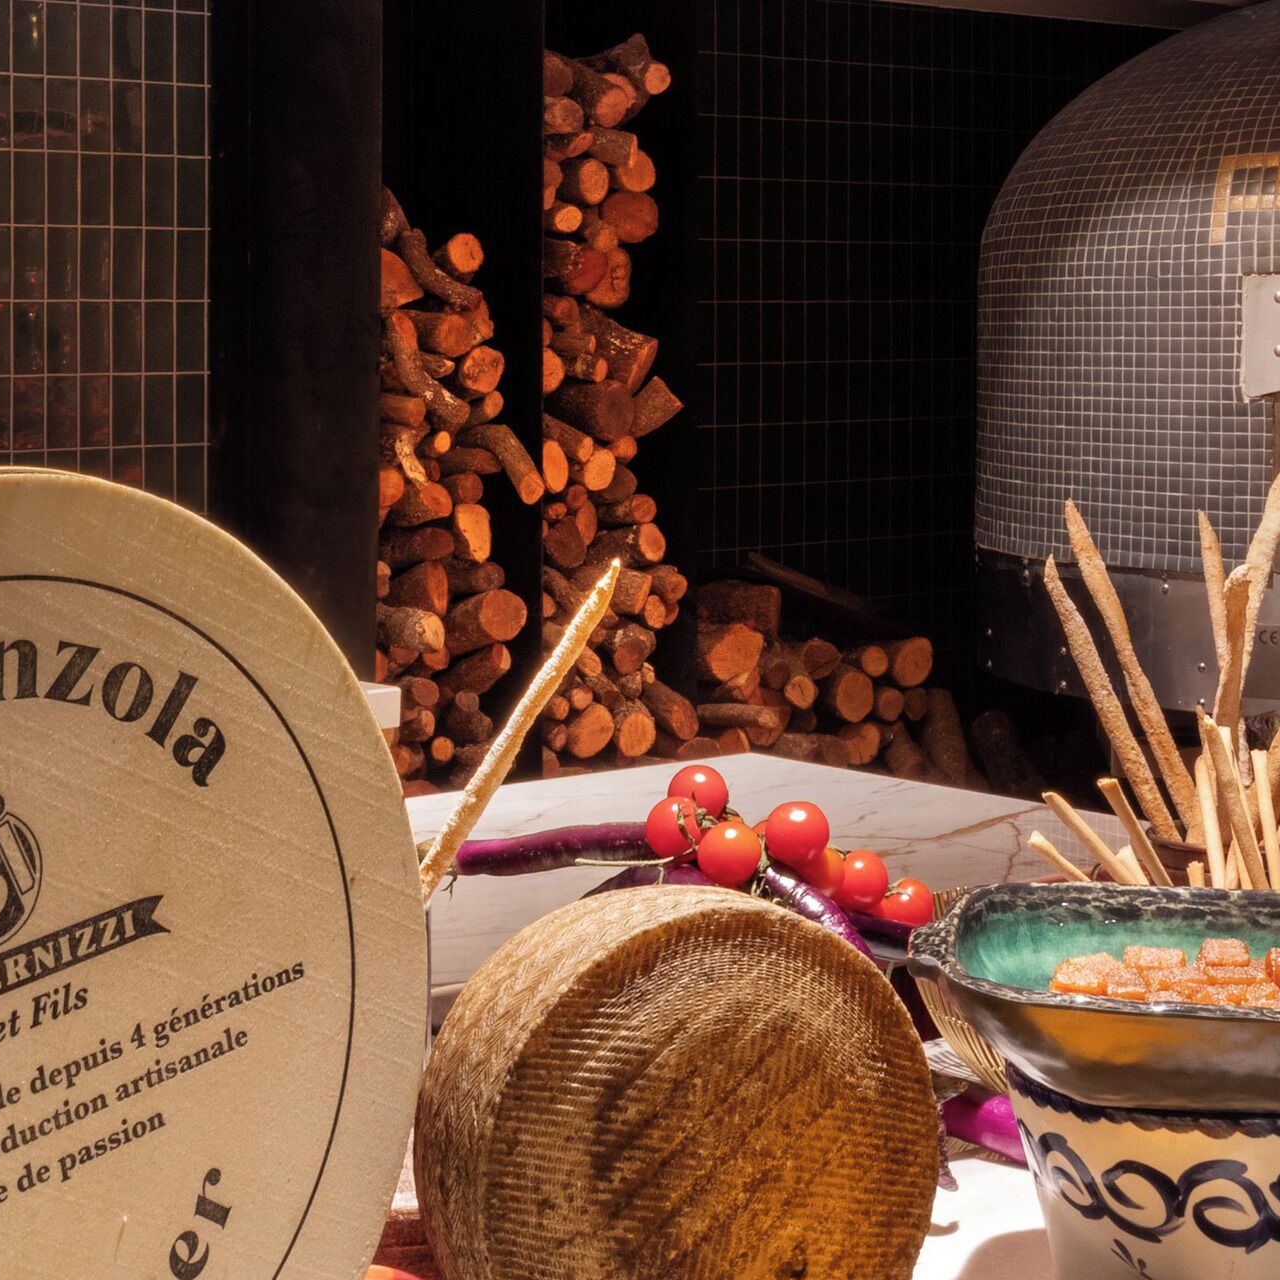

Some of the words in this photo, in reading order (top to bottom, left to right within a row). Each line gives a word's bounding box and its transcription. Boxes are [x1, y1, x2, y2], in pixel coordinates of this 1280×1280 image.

[1258, 630, 1279, 645] CE
[29, 984, 90, 1031] Fils
[29, 1037, 125, 1098] depuis
[129, 1022, 148, 1050] 4
[153, 960, 307, 1042] générations
[115, 1029, 249, 1101] artisanale
[16, 1160, 52, 1193] de
[58, 1109, 167, 1182] passion
